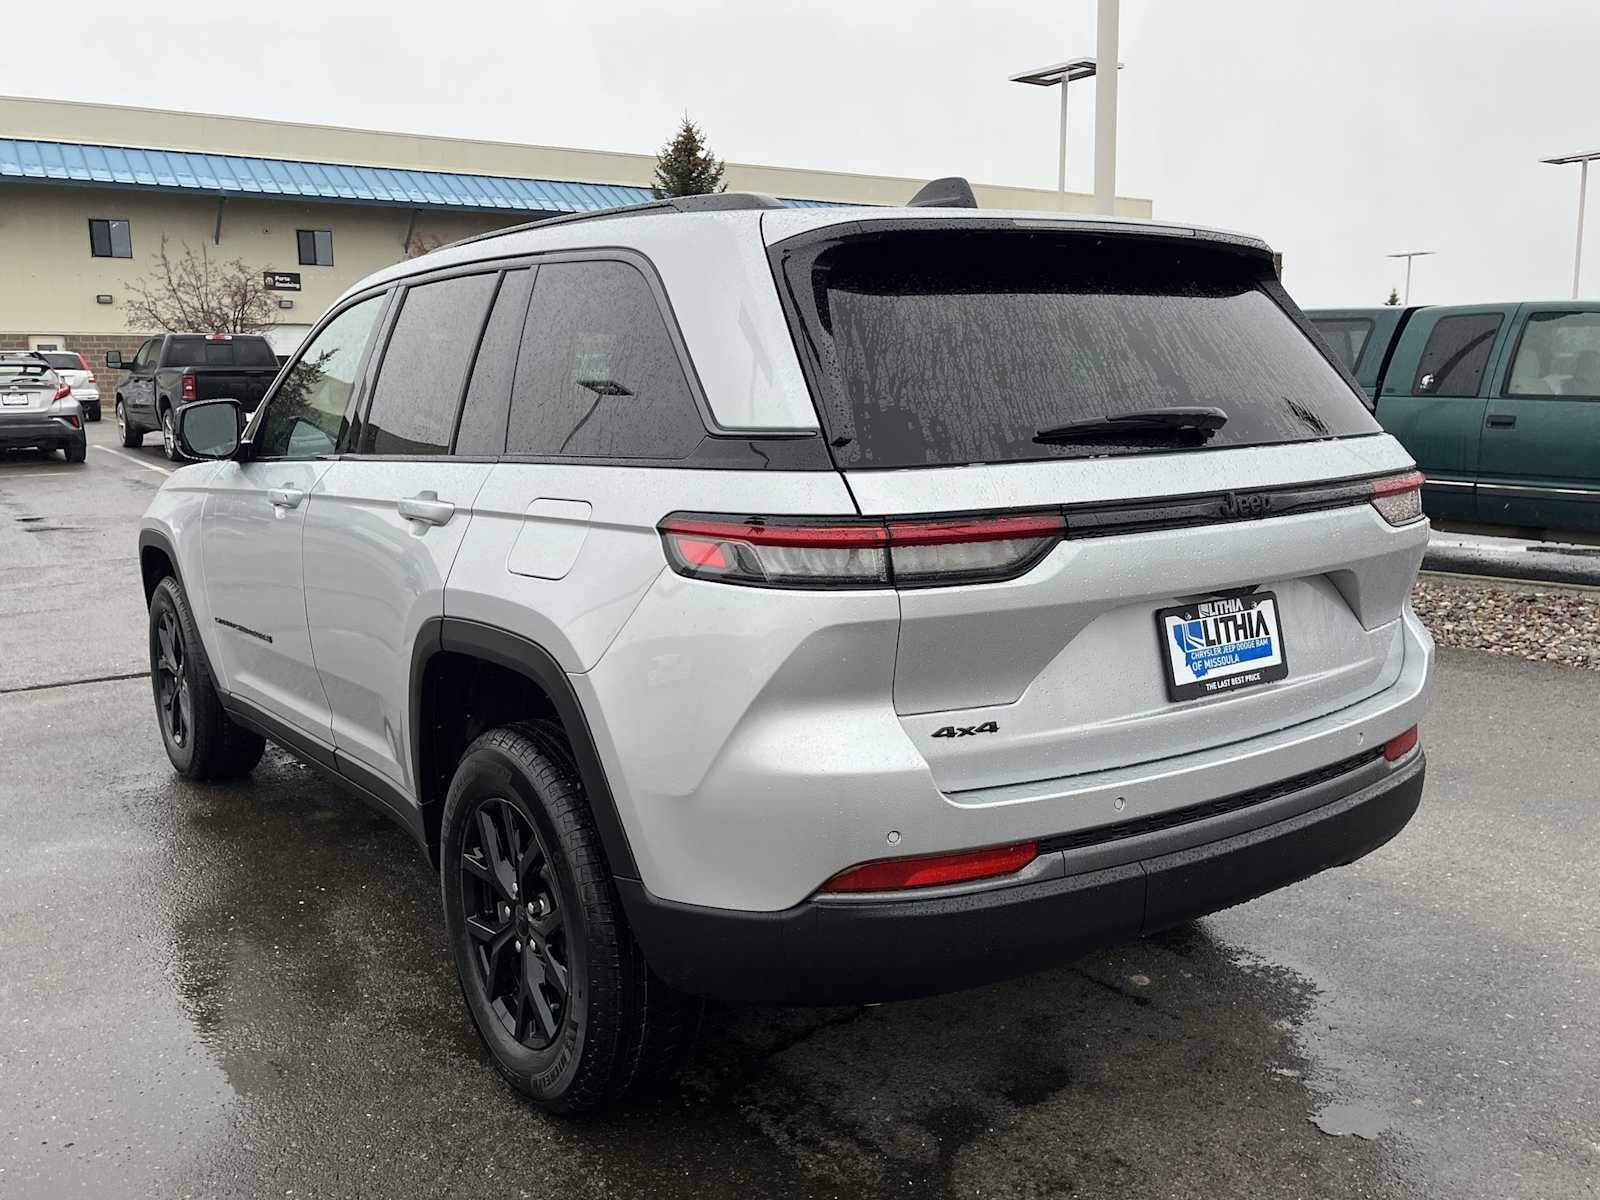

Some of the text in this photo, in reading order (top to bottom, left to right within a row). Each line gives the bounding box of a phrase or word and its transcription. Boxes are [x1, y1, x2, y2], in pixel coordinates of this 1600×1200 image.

[1220, 491, 1272, 518] Jeep
[1208, 598, 1244, 616] LITHIA
[1202, 609, 1270, 647] LITHIA
[1191, 638, 1269, 660] CHRYSLER JEEP DODGE RAM
[1192, 653, 1240, 671] OF MISSOULA
[1206, 672, 1261, 691] THE LAST BEST PRICE
[931, 721, 1000, 738] 4x4
